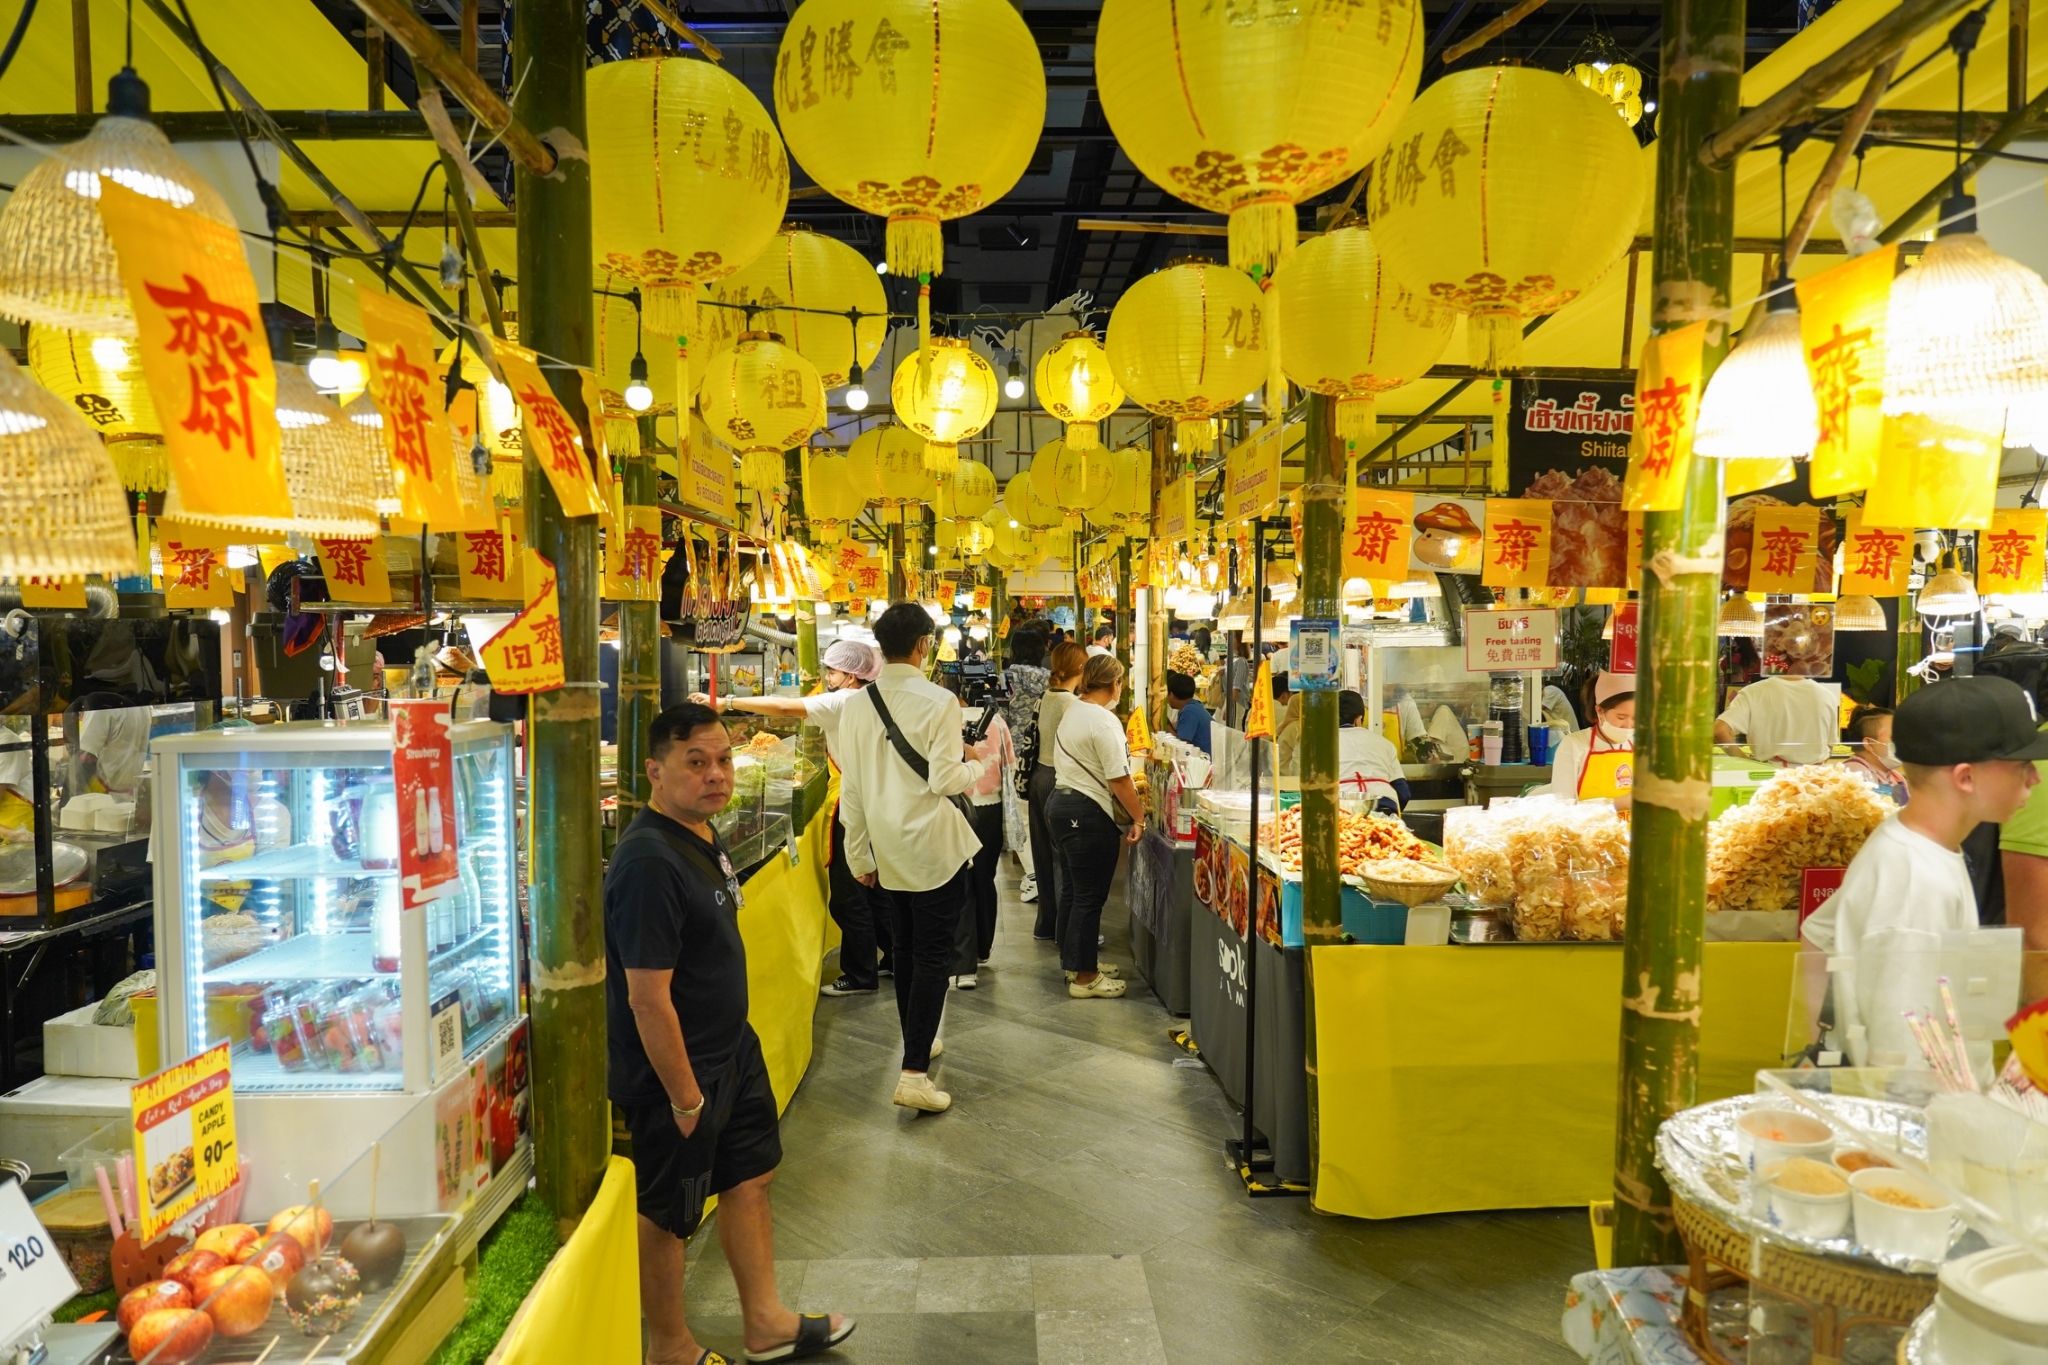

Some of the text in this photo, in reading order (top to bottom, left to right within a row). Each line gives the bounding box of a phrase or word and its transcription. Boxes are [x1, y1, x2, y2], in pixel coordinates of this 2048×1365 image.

[1371, 127, 1471, 223] 皇勝會
[757, 363, 806, 410] 祖
[1581, 441, 1631, 458] Shiita
[1486, 637, 1541, 646] Free tasting
[406, 748, 440, 760] Strawberry
[1813, 887, 1838, 903] ถุงล
[144, 1110, 159, 1126] Eat
[160, 1109, 166, 1118] a
[168, 1096, 183, 1115] Red
[208, 1077, 224, 1094] Day
[198, 1101, 225, 1124] CANDY
[201, 1114, 227, 1138] APPLE
[8, 1235, 44, 1271] 120
